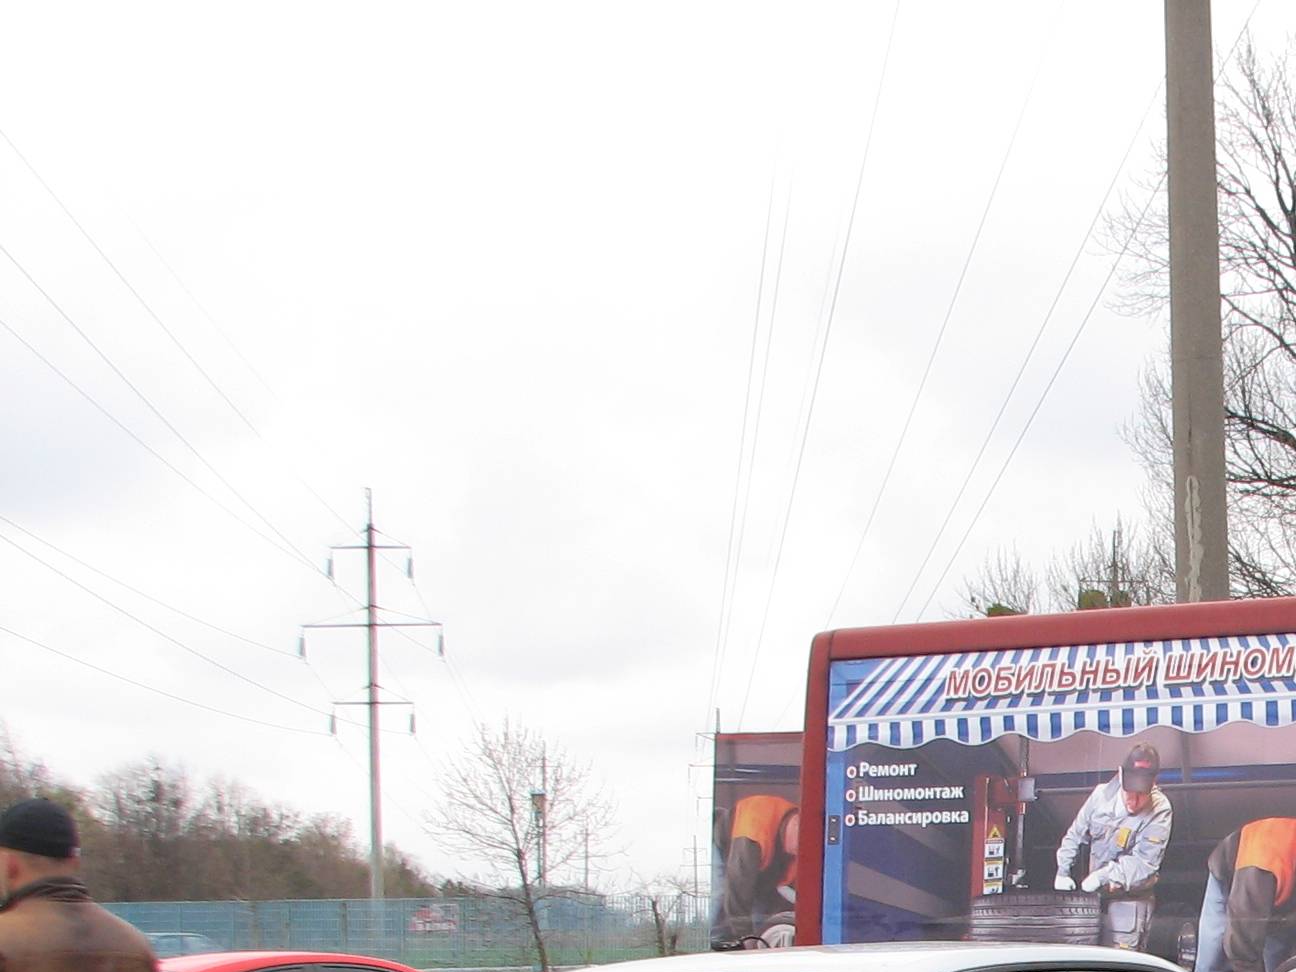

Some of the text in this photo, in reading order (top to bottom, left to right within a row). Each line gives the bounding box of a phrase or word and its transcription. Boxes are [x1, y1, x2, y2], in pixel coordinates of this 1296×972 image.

[945, 648, 1158, 699] МОБИЛЬНЫЙ
[859, 762, 917, 777] Ремонт
[858, 785, 964, 801] Шиномонтаж
[858, 810, 969, 827] Балансировка
